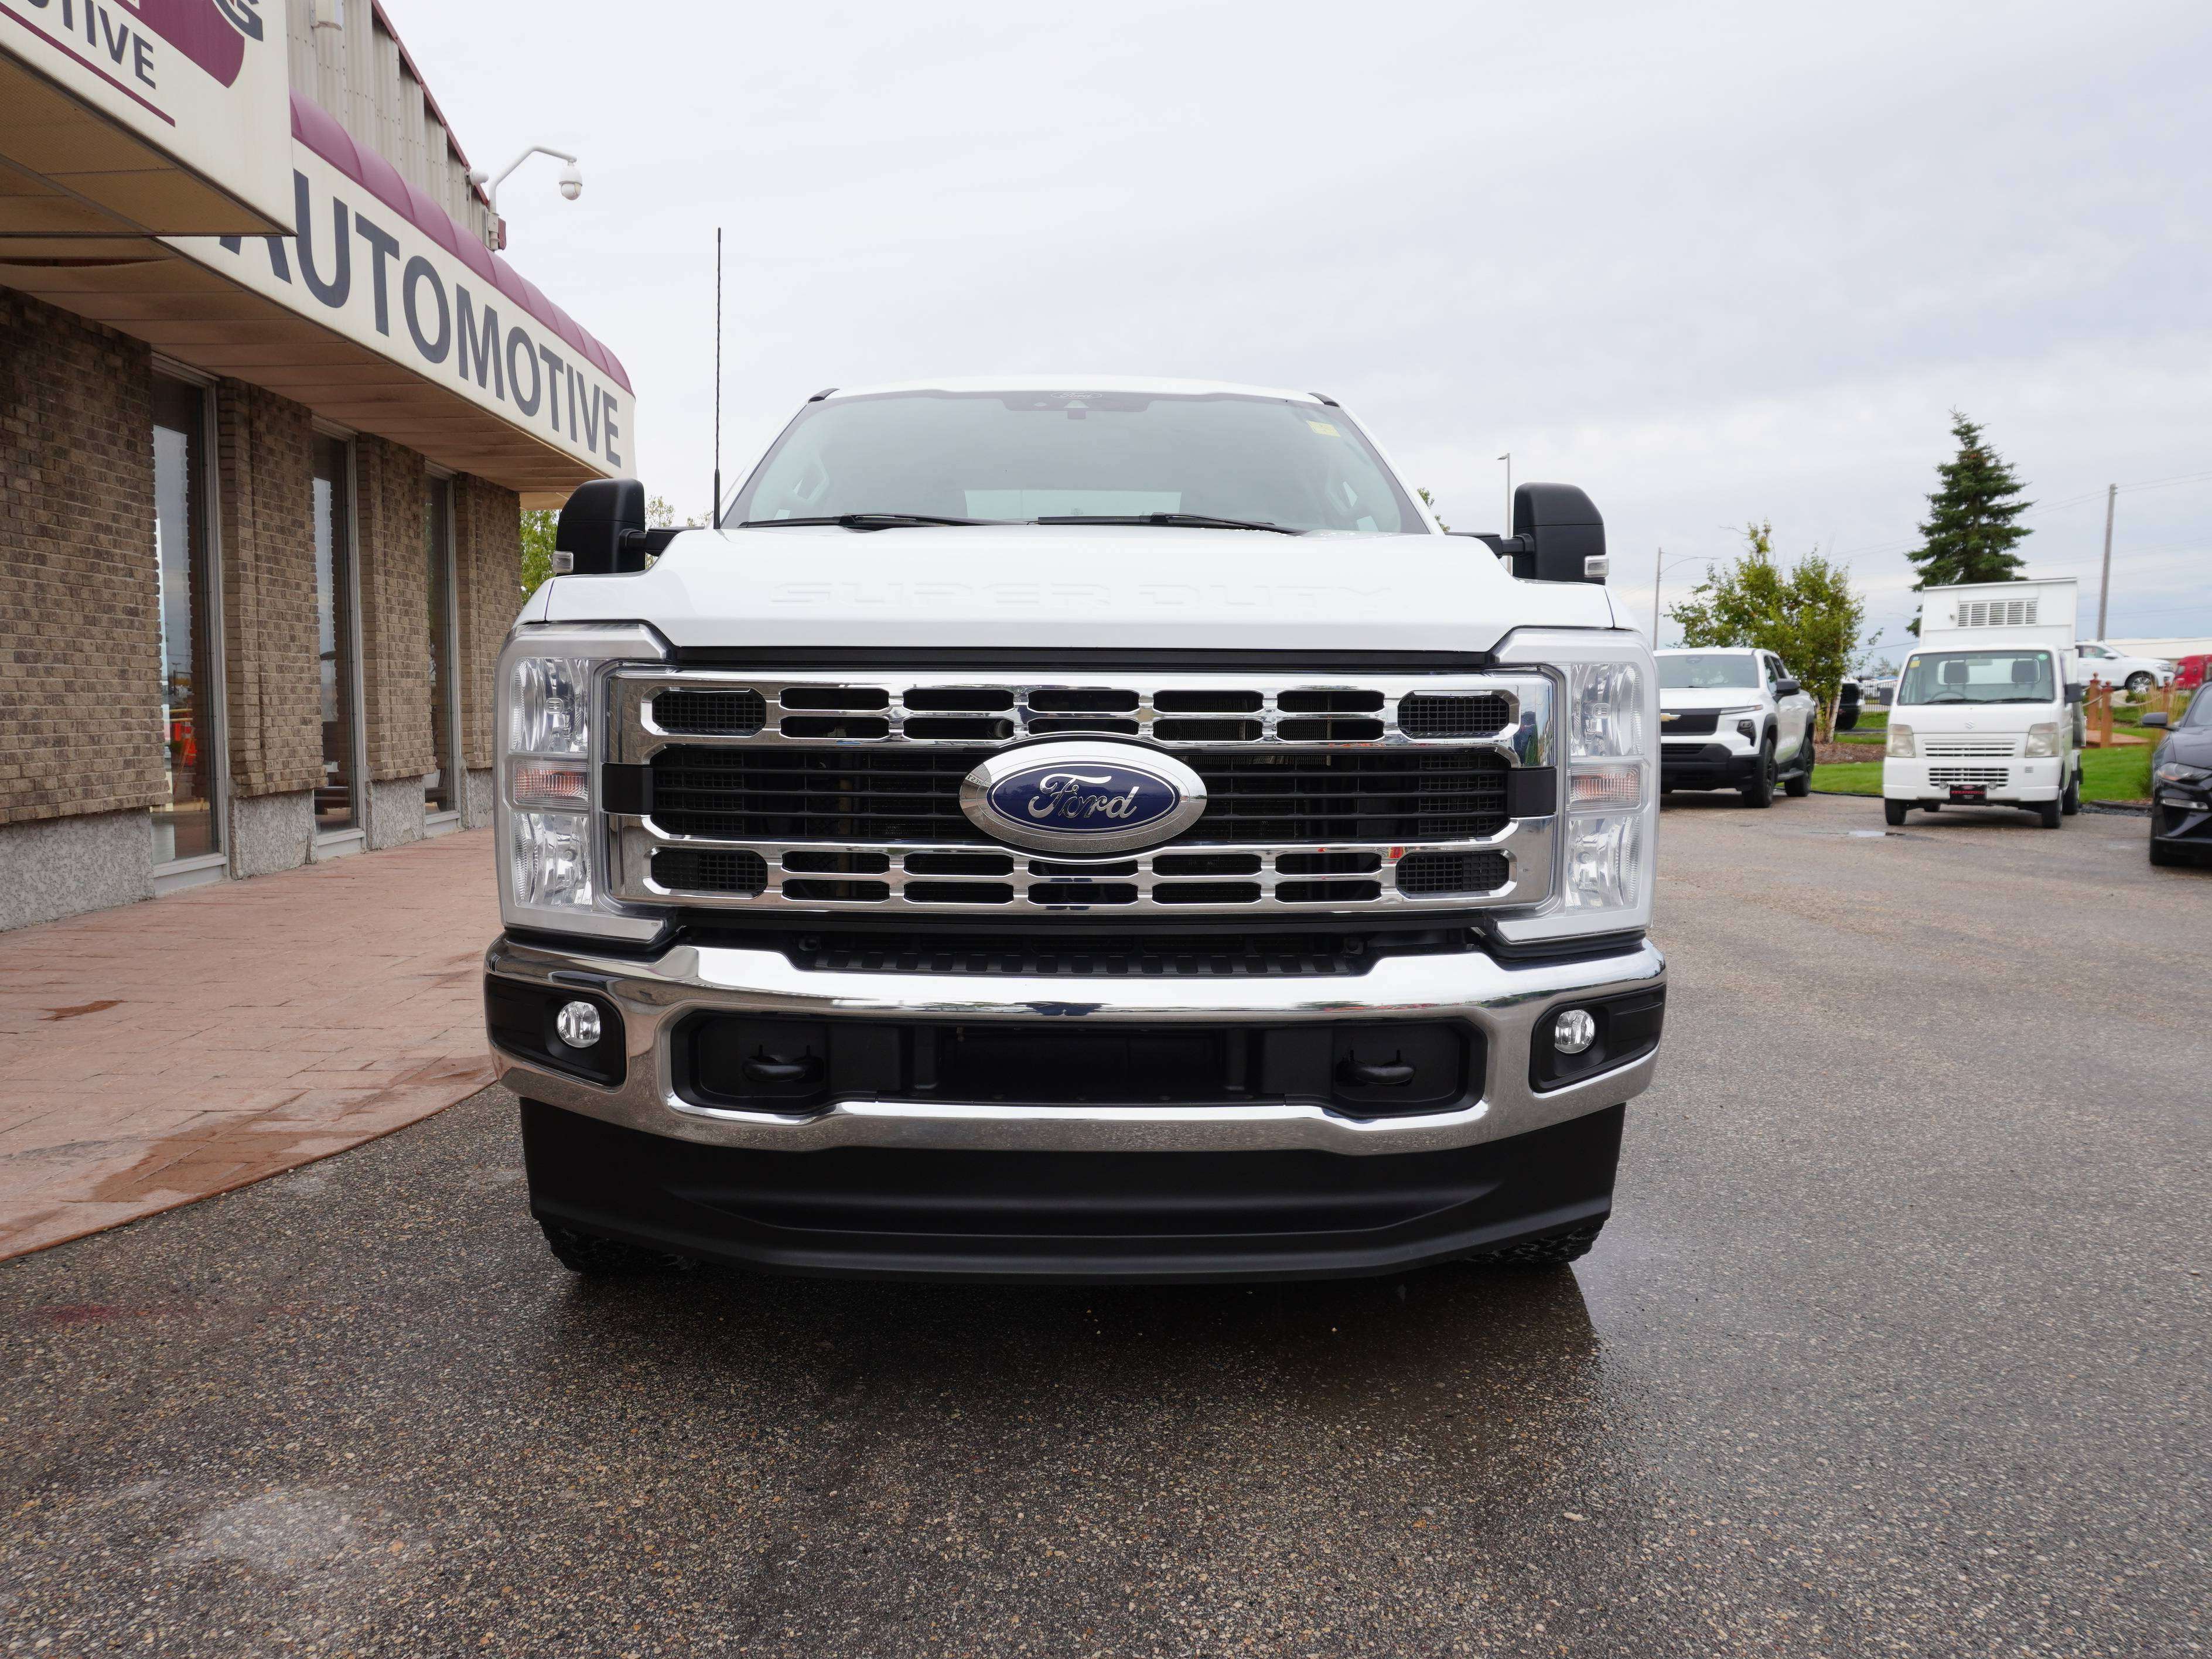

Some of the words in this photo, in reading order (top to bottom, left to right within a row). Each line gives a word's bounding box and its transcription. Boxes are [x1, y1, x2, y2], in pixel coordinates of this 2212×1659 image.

[769, 581, 1111, 609] SUPER
[1138, 582, 1392, 612] DUTY
[1028, 773, 1139, 819] Ford
